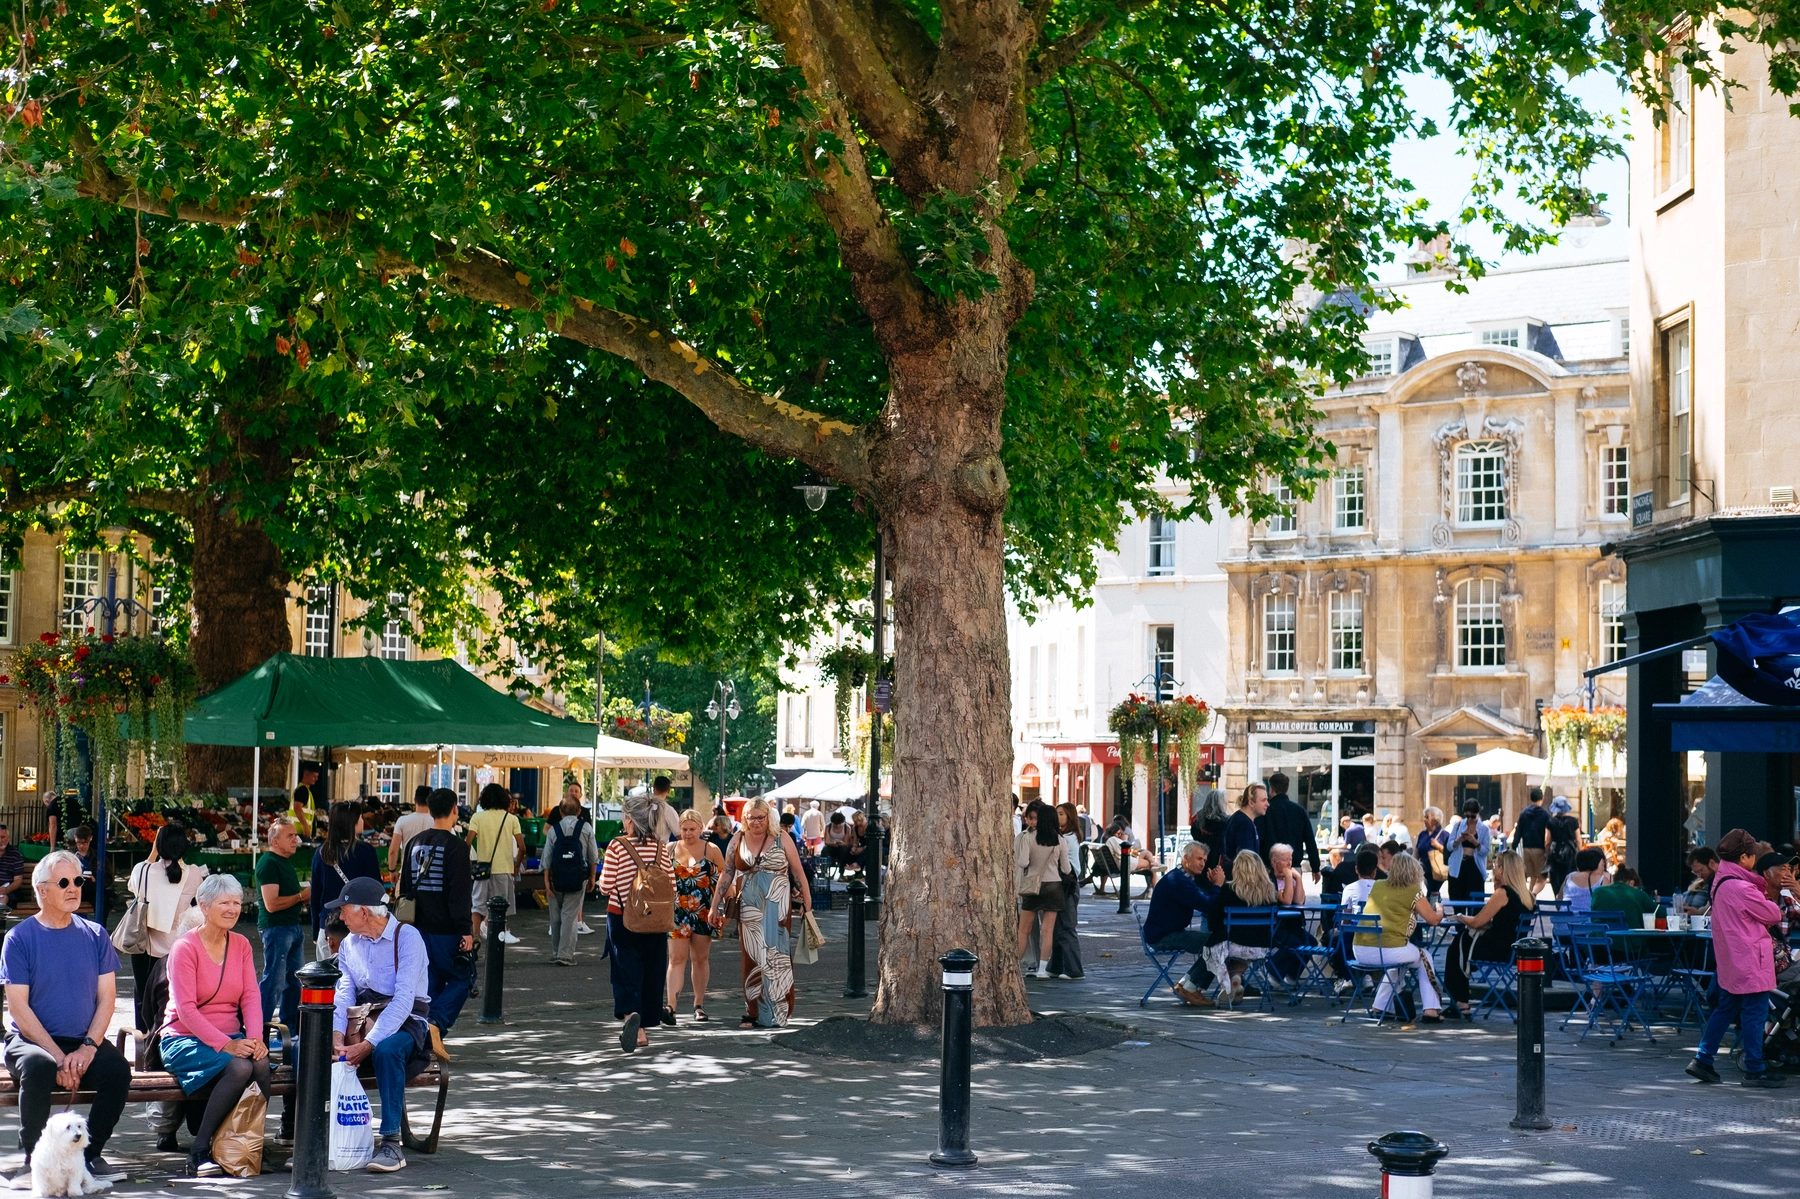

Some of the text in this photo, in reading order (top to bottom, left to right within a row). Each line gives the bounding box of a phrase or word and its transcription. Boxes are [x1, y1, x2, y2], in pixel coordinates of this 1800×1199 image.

[1256, 721, 1354, 731] THE BATH COFFEE COMPANY
[388, 752, 415, 760] PIZZERIA
[500, 754, 534, 763] PIZZERIA
